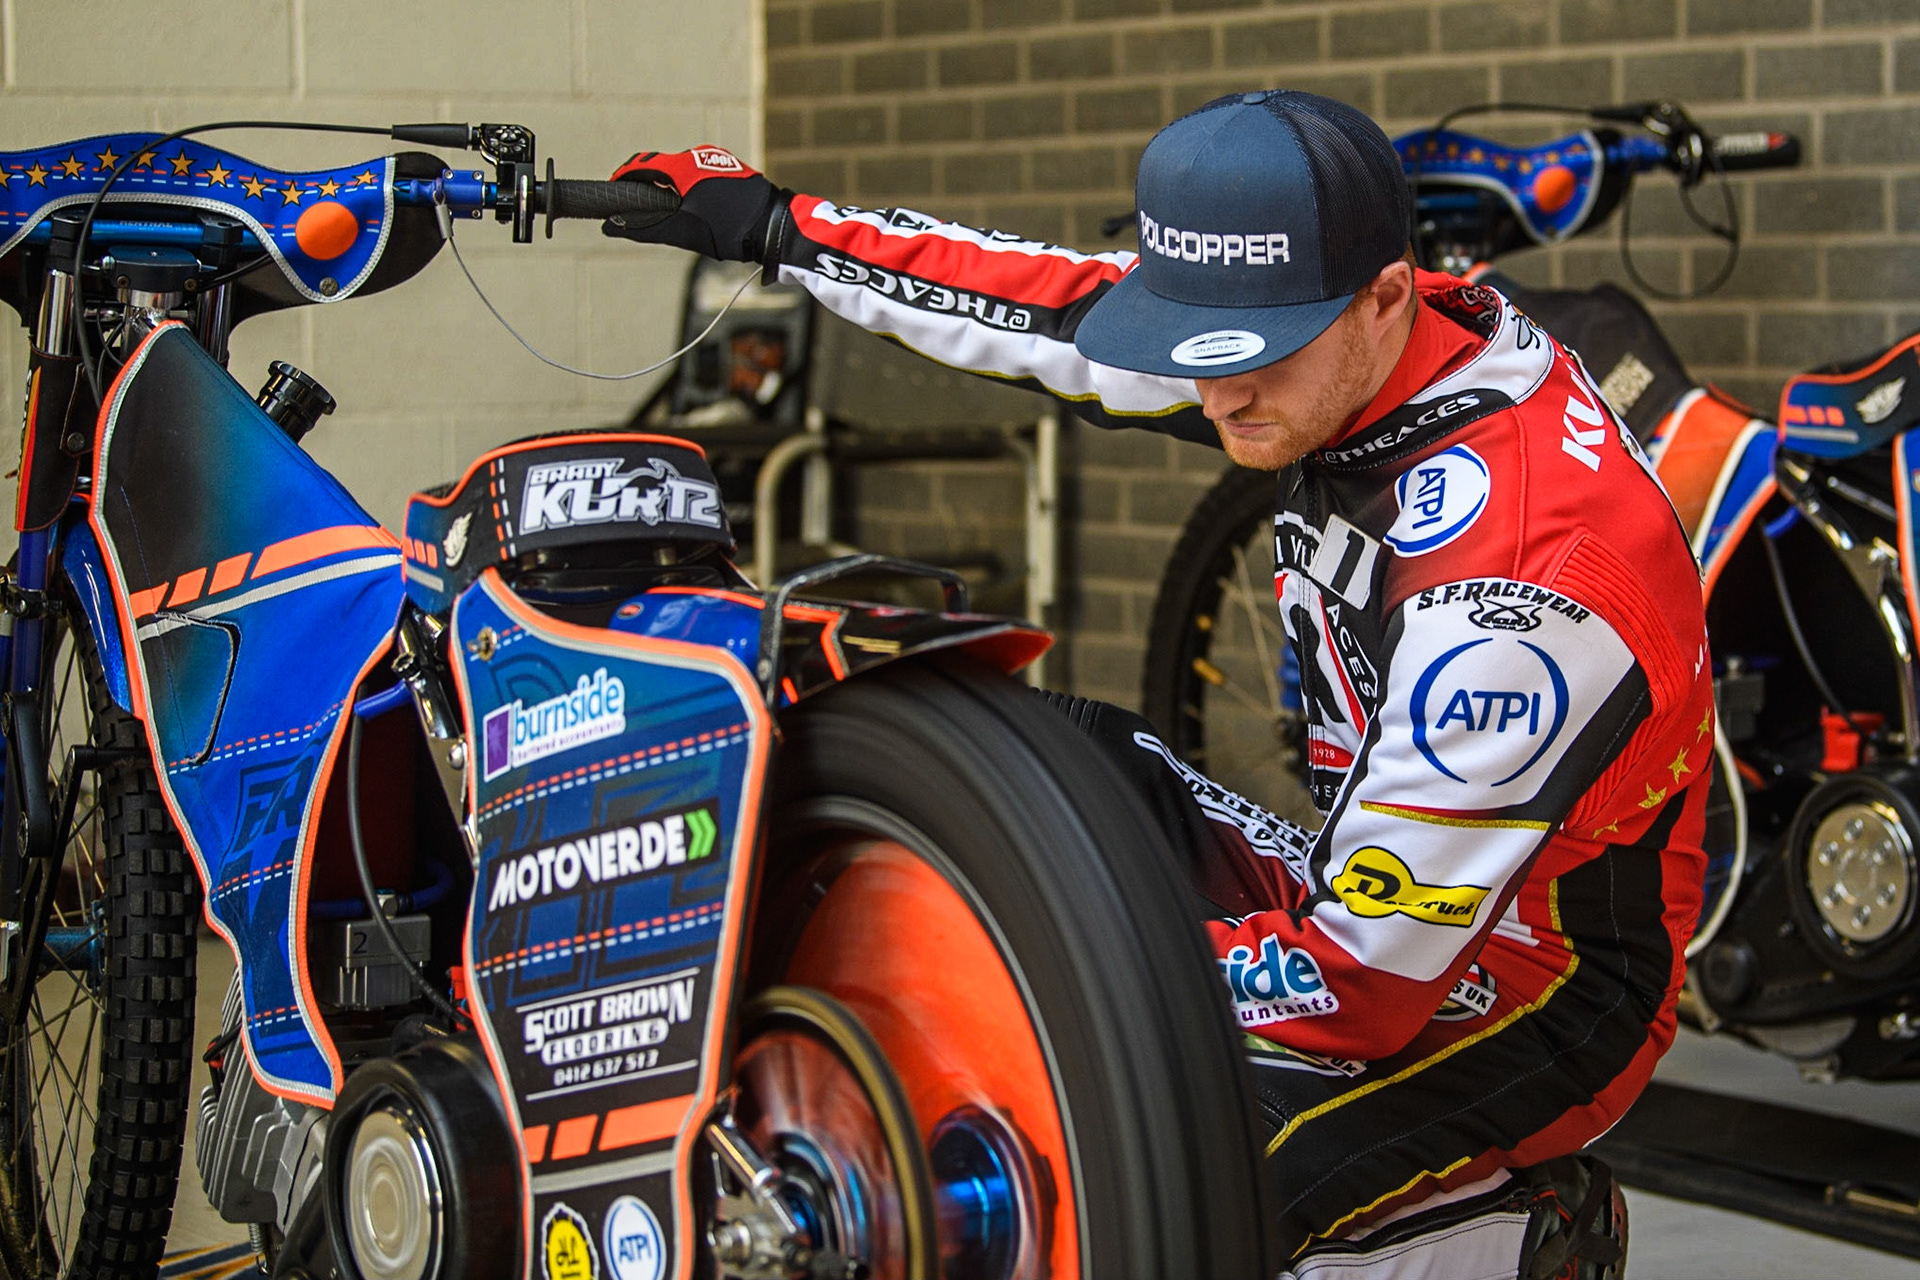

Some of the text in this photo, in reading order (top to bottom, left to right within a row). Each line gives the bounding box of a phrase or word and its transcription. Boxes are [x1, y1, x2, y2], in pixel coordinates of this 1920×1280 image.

[1140, 210, 1290, 266] POLCOPPER
[814, 252, 1032, 331] @THEACES
[1194, 343, 1241, 354] SNAPBACK
[1325, 394, 1481, 463] @THEACES
[530, 462, 618, 486] BRADY
[524, 476, 721, 531] KURTZ
[1412, 468, 1446, 530] ATPI
[515, 672, 620, 746] burnside
[1435, 688, 1541, 735] ATPI
[1313, 748, 1336, 760] 1928
[488, 814, 687, 913] MOTOVERDE
[353, 931, 368, 954] 2
[524, 977, 695, 1055] SCOTT BROWN
[1237, 995, 1334, 1022] untants
[1465, 986, 1490, 1009] UK
[549, 1021, 660, 1062] FLOORING
[553, 1048, 659, 1087] 0412 637 513
[618, 1233, 652, 1263] ATPI
